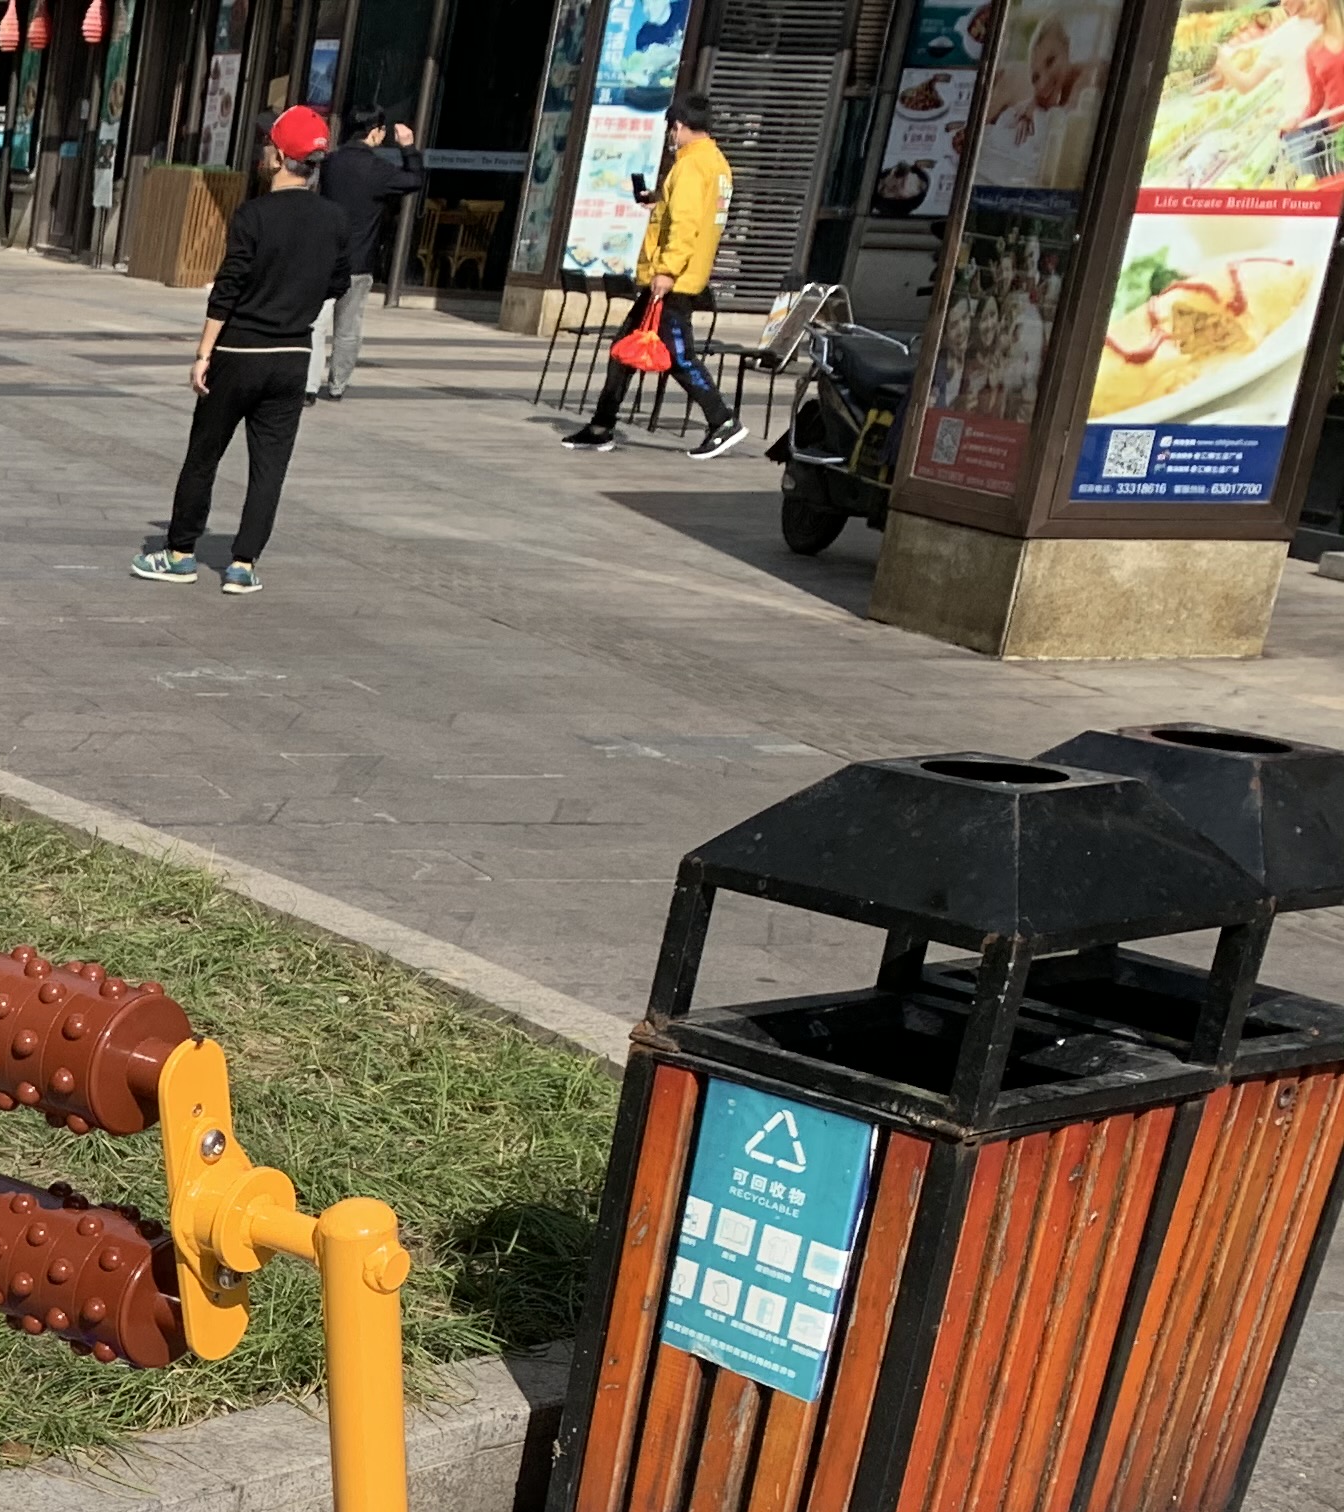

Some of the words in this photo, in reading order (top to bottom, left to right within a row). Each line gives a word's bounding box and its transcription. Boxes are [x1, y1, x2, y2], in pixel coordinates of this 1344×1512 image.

[1154, 196, 1179, 208] Life
[1182, 196, 1223, 208] Create
[1226, 196, 1278, 209] Brilliant
[1281, 197, 1322, 210] Future
[728, 1185, 800, 1219] RECYCLABLE
[732, 1166, 807, 1207] 可回收物
